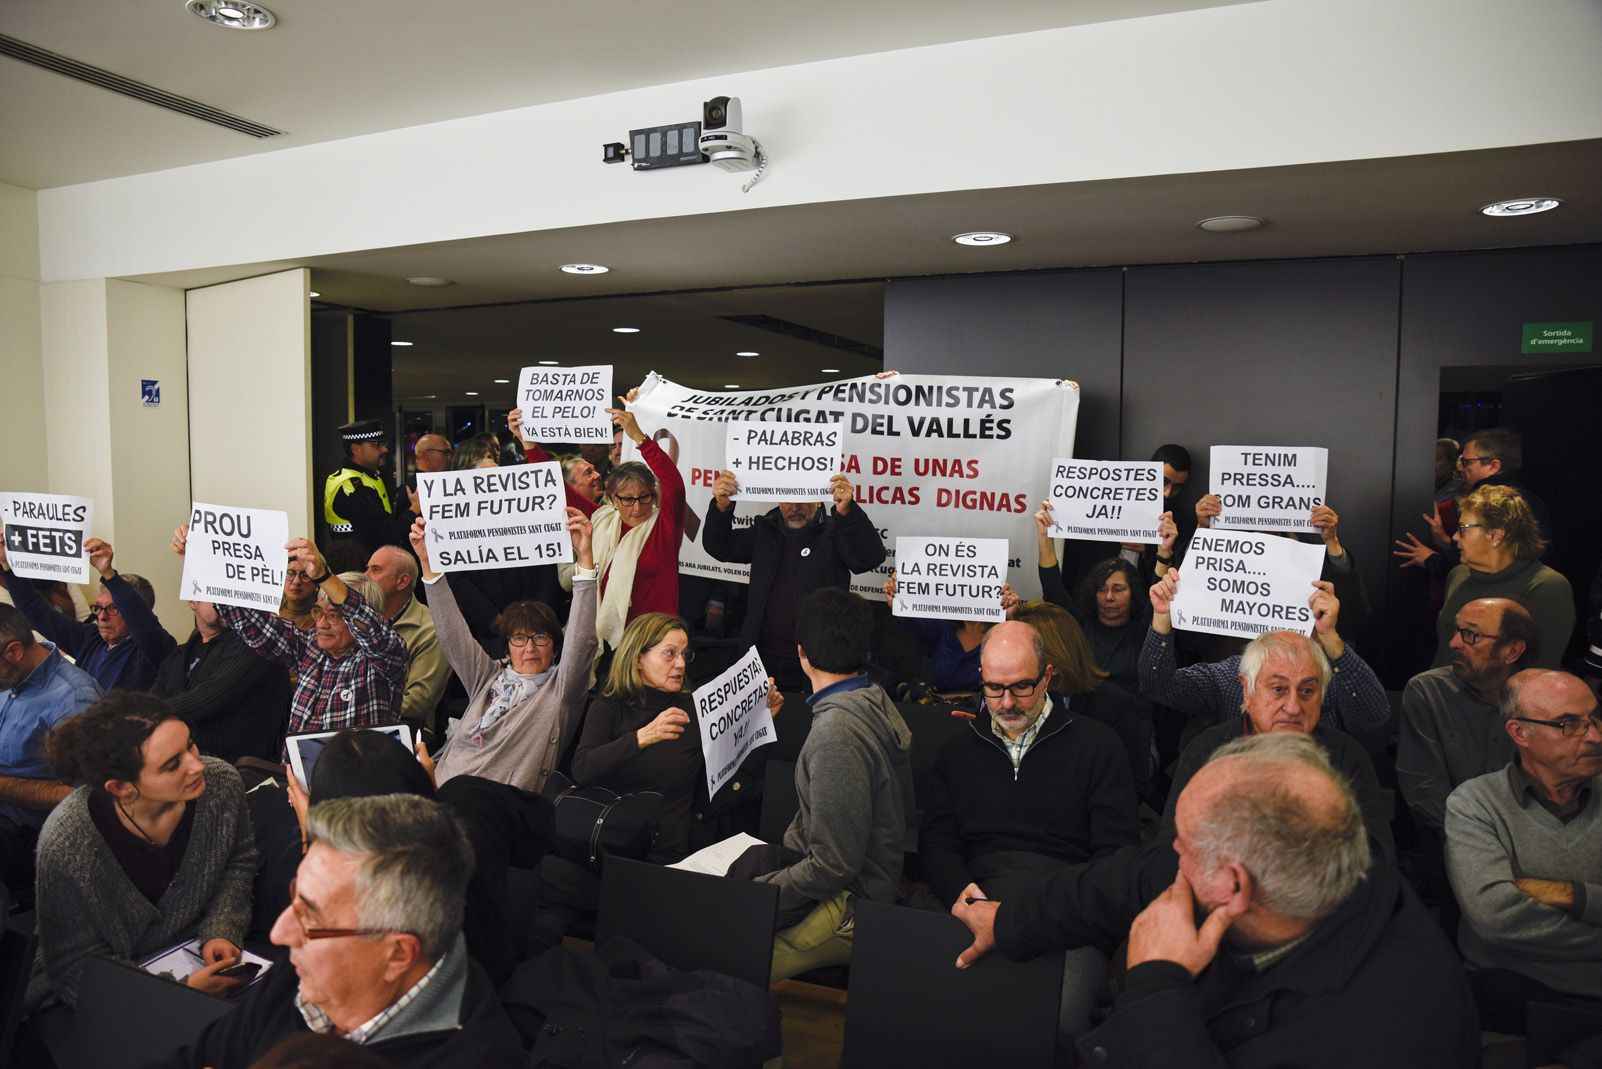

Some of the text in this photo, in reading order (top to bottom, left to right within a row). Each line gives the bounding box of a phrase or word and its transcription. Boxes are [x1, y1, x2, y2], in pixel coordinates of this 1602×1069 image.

[1530, 337, 1584, 346] d'emergència
[1543, 329, 1571, 337] Sortida
[530, 372, 600, 386] BASTA DE
[525, 388, 605, 401] TOMARNOS
[681, 382, 1015, 410] JUBILADOS Y PENSIONISTAS
[531, 406, 596, 418] EL PELO!
[524, 425, 608, 438] YA ESTÁ BIEN!
[850, 412, 900, 437] DEL
[907, 414, 1012, 440] VALLÉS
[746, 430, 837, 447] PALABRAS
[732, 458, 742, 469] +
[748, 456, 834, 471] HECHOS!
[872, 456, 902, 476] DE
[914, 458, 979, 480] UNAS
[1241, 452, 1297, 467] TENIM
[1056, 465, 1157, 482] RESPOSTES
[1221, 472, 1316, 488] PRESSA....
[424, 468, 557, 498] Y LA REVISTA
[936, 488, 1027, 514] DIGNAS
[1053, 484, 1159, 501] CONCRETES
[12, 500, 86, 522] PARAULES
[429, 494, 558, 520] FEM FUTUR?
[1085, 504, 1122, 520] JA!!
[191, 510, 252, 538] PROU
[1224, 516, 1256, 525] PLATAFORMA
[1257, 517, 1292, 526] PENSIONISTES
[1293, 519, 1306, 528] SANT
[448, 522, 562, 540] PLATAFORMA PENSIONISTES SANT CUGAT
[1067, 525, 1157, 538] PLATAFORMA PENSIONISTES SANT CUGAT
[10, 529, 77, 554] + FETS
[925, 541, 977, 558] ON ÉS
[212, 540, 265, 561] PRESA
[439, 542, 562, 566] SALÍA EL 15!
[226, 563, 283, 586] DE PÈL!
[696, 563, 722, 574] JUBILATS,
[723, 568, 742, 576] VOLEN
[901, 562, 922, 576] LA
[926, 563, 999, 579] REVISTA
[1195, 556, 1266, 576] PRISA....
[860, 586, 886, 594] DEFENS
[897, 581, 1003, 599] FEM FUTUR?
[1206, 577, 1271, 597] SOMOS
[912, 604, 941, 612] PLATAFORMA
[1220, 598, 1310, 622] MAYORES
[1192, 616, 1230, 630] PLATAFORMA
[1230, 620, 1270, 633] PENSIONISTES
[709, 680, 769, 741] CONCRETAS
